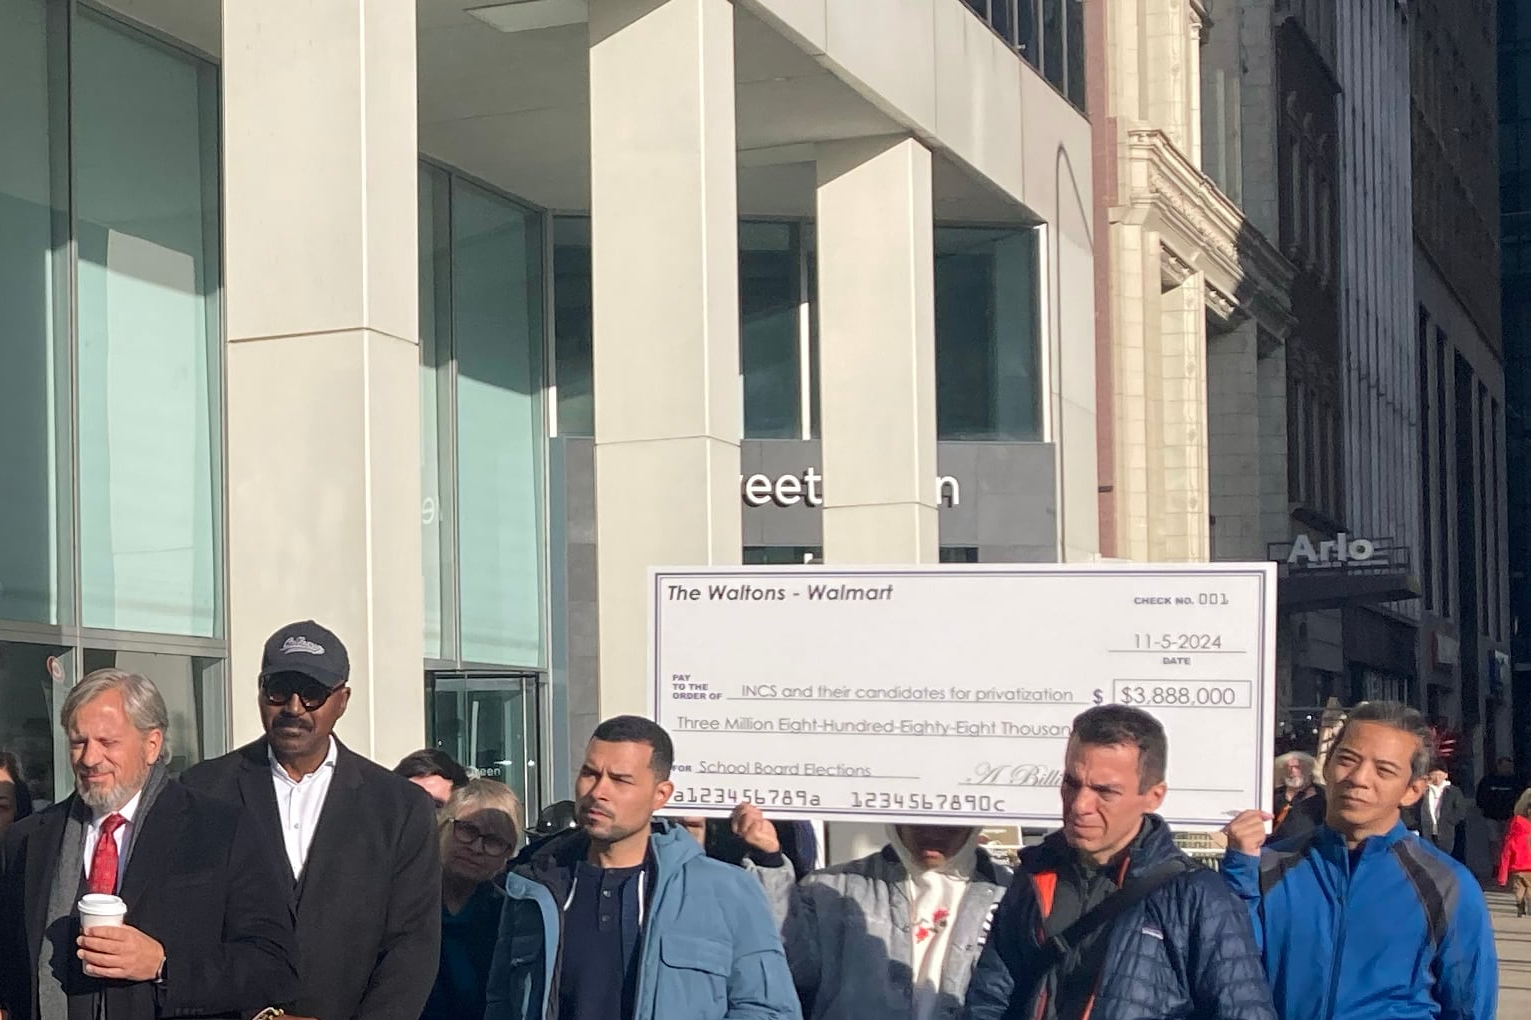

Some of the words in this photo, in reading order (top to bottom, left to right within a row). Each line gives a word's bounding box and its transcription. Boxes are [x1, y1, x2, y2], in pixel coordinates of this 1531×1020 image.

[1287, 533, 1375, 562] Arlo
[668, 585, 701, 601] The
[708, 584, 786, 601] Waltons
[808, 584, 894, 600] Walmart
[1133, 597, 1172, 605] CHECK
[1175, 597, 1195, 605] NO.
[1199, 593, 1229, 605] 001
[1134, 633, 1222, 650] 11-5-2024
[1162, 657, 1191, 665] DATE
[672, 692, 706, 700] ORDER
[709, 692, 723, 700] OF
[742, 684, 777, 698] INCS
[781, 684, 813, 698] and
[819, 684, 852, 698] their
[854, 685, 946, 700] candidates
[950, 686, 971, 700] for
[976, 687, 1074, 702] privatization
[1121, 686, 1236, 705] $3,888,000
[678, 716, 720, 730] Three
[725, 717, 774, 731] Million
[779, 718, 996, 735] Eight-Hundred-Eighty-Eight
[1001, 721, 1070, 736] Thousan
[671, 764, 692, 773] FOR
[699, 760, 750, 774] School
[754, 761, 800, 776] Board
[804, 763, 871, 777] Elections
[851, 791, 1005, 812] 1234567890c
